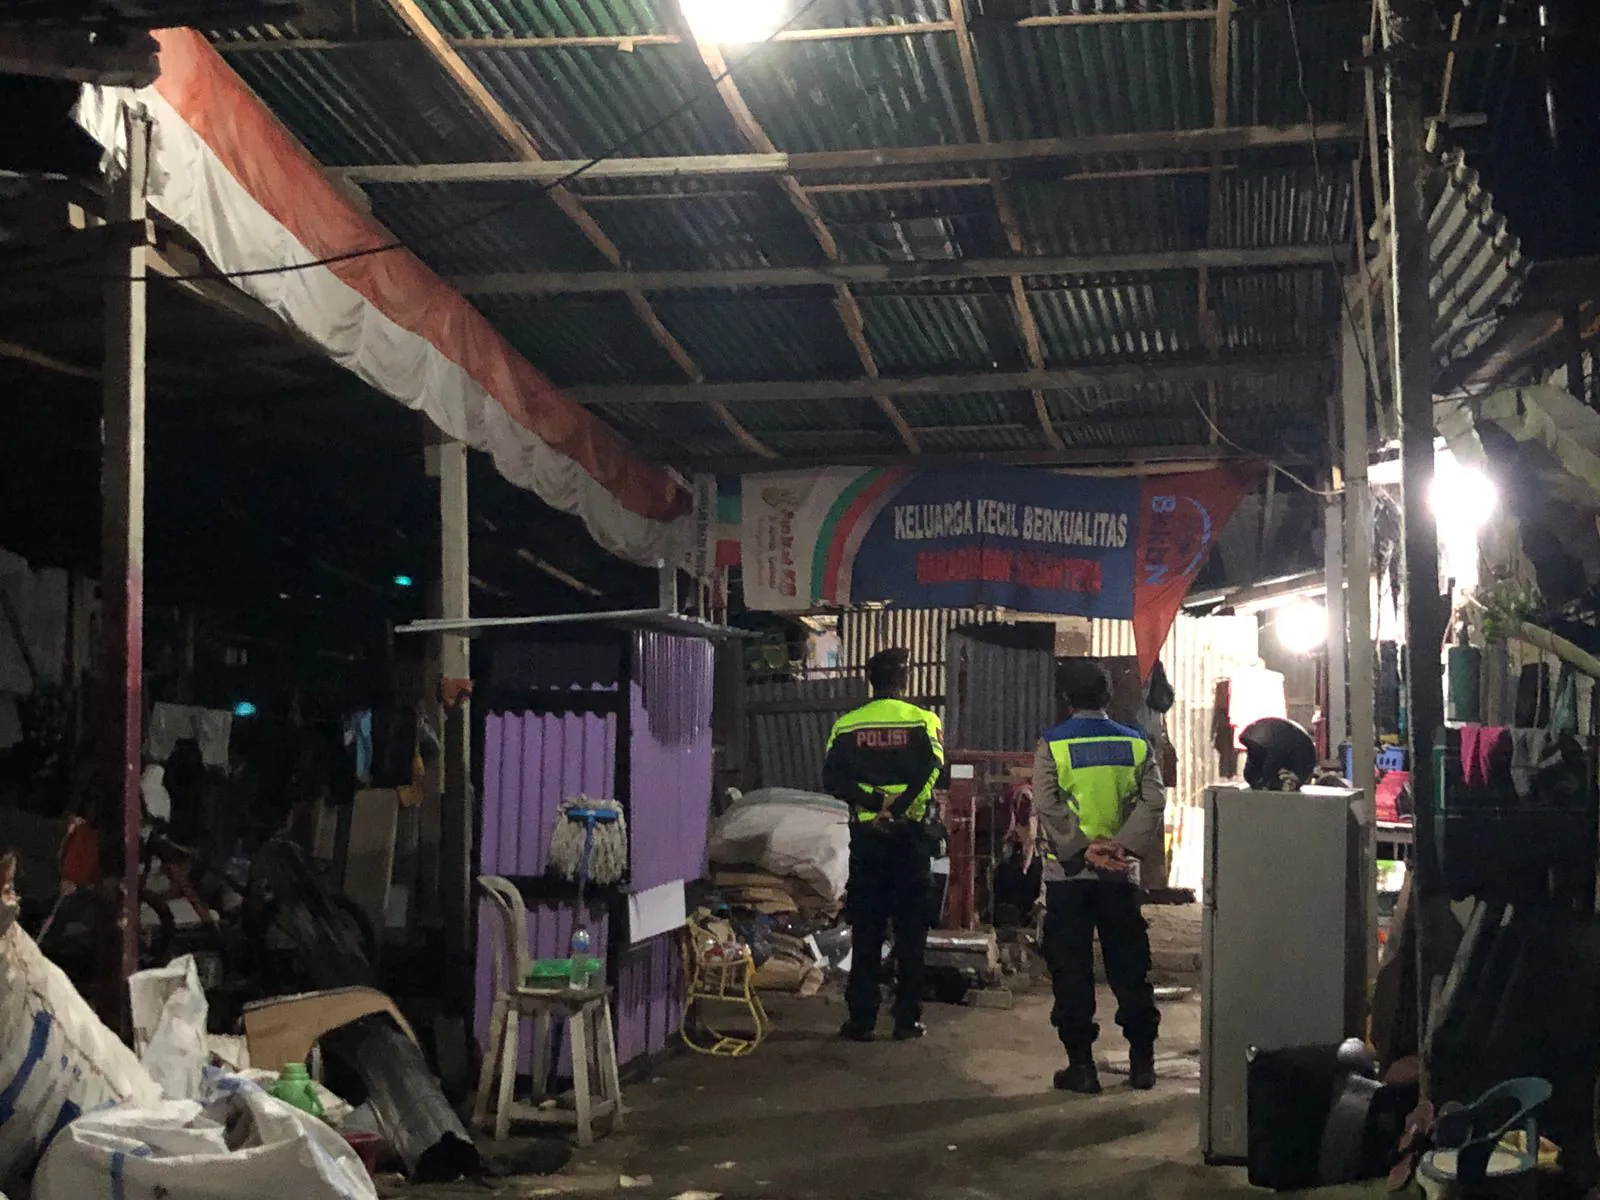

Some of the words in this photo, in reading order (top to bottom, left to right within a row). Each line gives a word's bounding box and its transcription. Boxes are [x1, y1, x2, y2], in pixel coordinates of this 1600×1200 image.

[894, 502, 973, 540] KELUARGA
[977, 499, 1019, 538] KECIL
[1023, 506, 1128, 548] BERKUALITAS
[857, 729, 908, 747] POLISI
